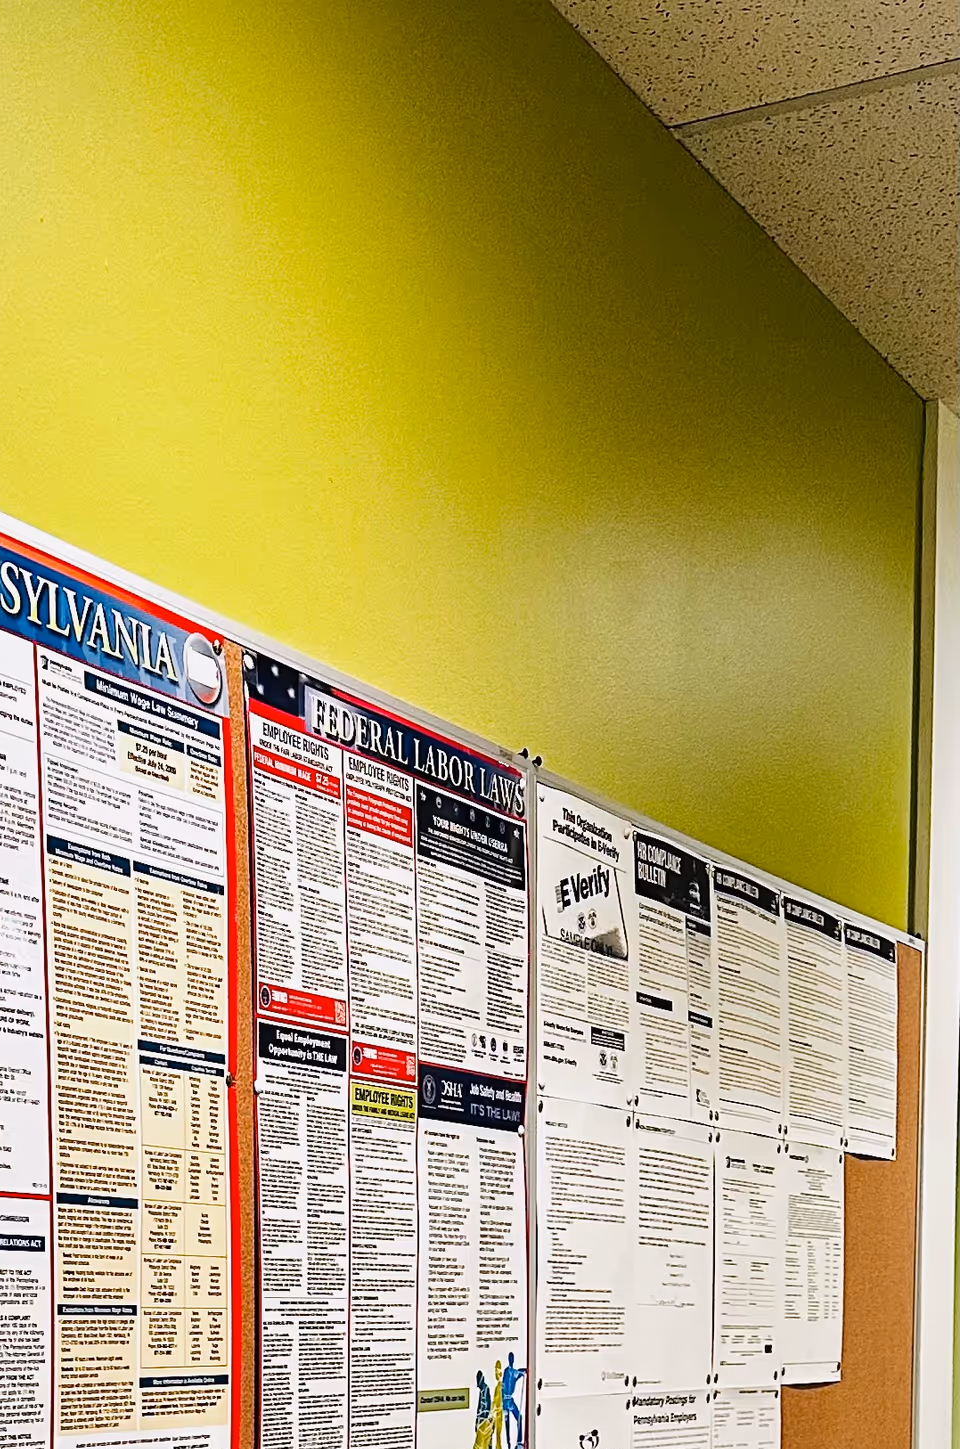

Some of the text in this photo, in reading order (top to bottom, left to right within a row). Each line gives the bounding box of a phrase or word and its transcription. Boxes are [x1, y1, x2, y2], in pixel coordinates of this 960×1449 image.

[262, 722, 328, 759] EMPLOYEE RIGHTS
[313, 697, 525, 815] FEDERAL LABOR LAWS
[348, 757, 411, 790] EMPLOYEE RIGHTS
[552, 820, 619, 861] Participates in E-Verify
[562, 807, 611, 841] This Organization
[276, 1029, 330, 1048] Equal Employment
[355, 1087, 412, 1108] EMPLOYEE RIGHTS
